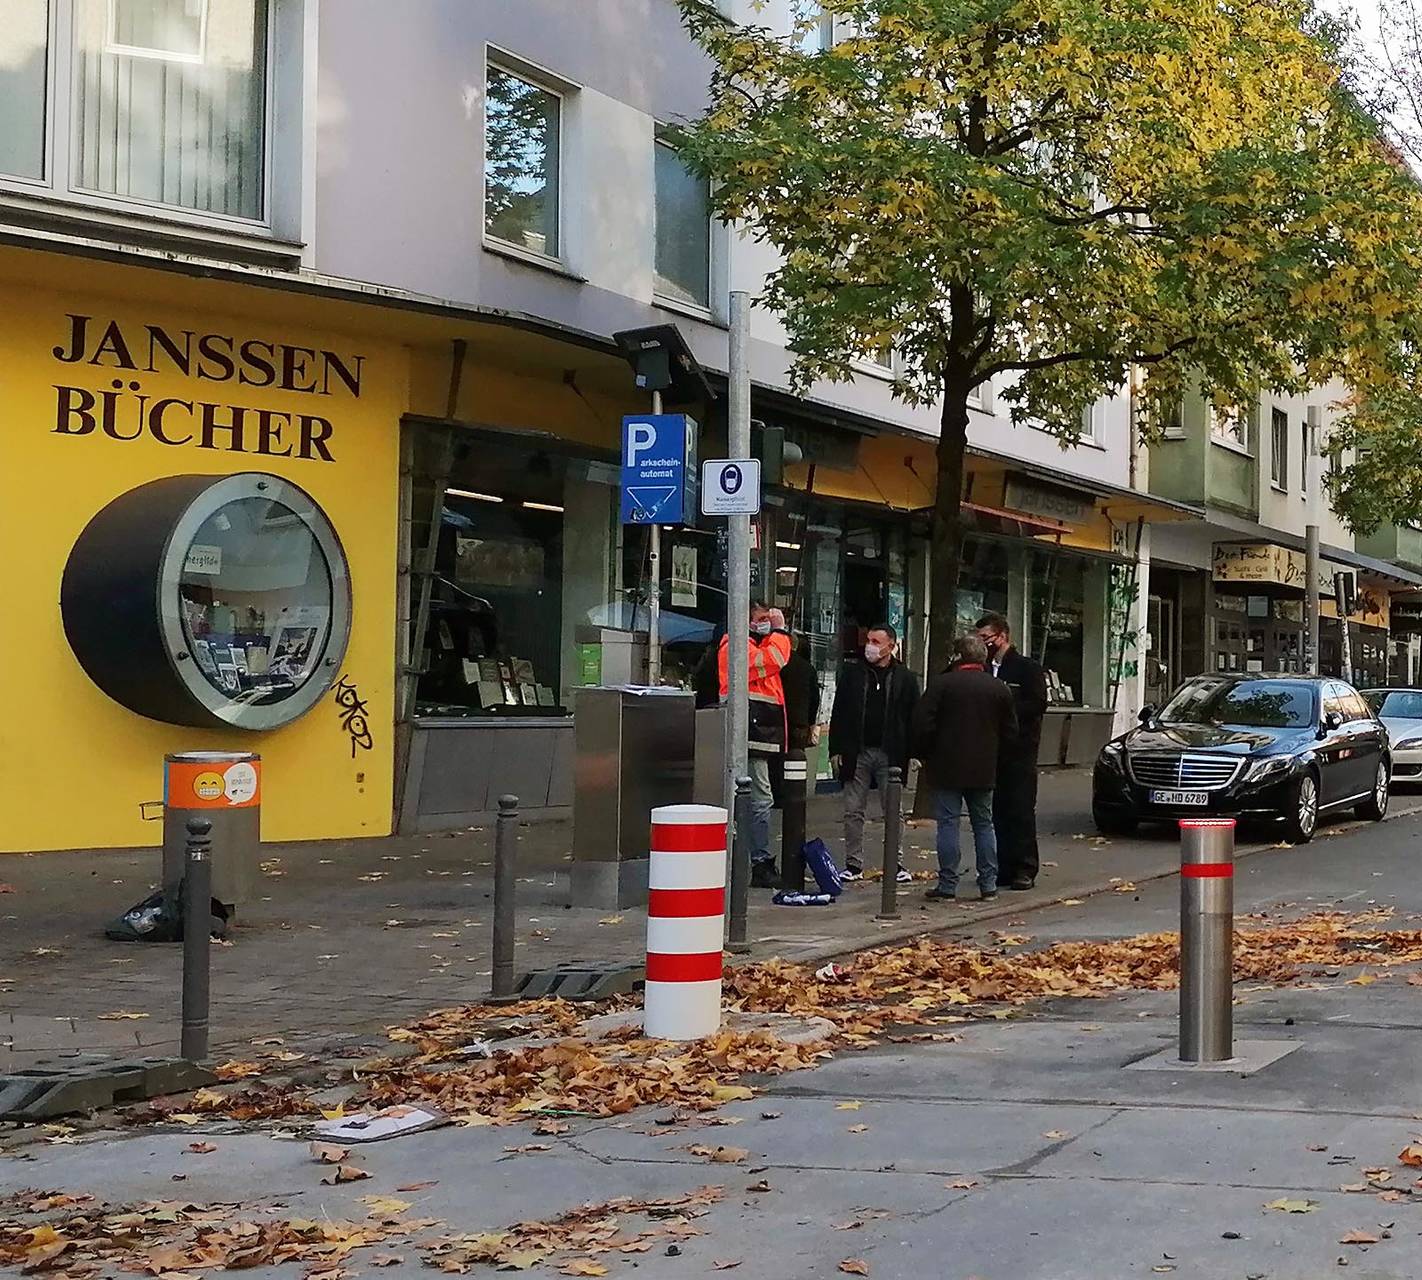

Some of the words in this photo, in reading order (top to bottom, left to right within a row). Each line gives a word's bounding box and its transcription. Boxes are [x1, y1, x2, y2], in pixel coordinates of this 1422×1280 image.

[52, 313, 367, 399] JANSSEN
[50, 379, 336, 462] BÜCHER
[627, 423, 657, 467] P
[639, 469, 674, 479] automat
[1184, 793, 1207, 804] 6789
